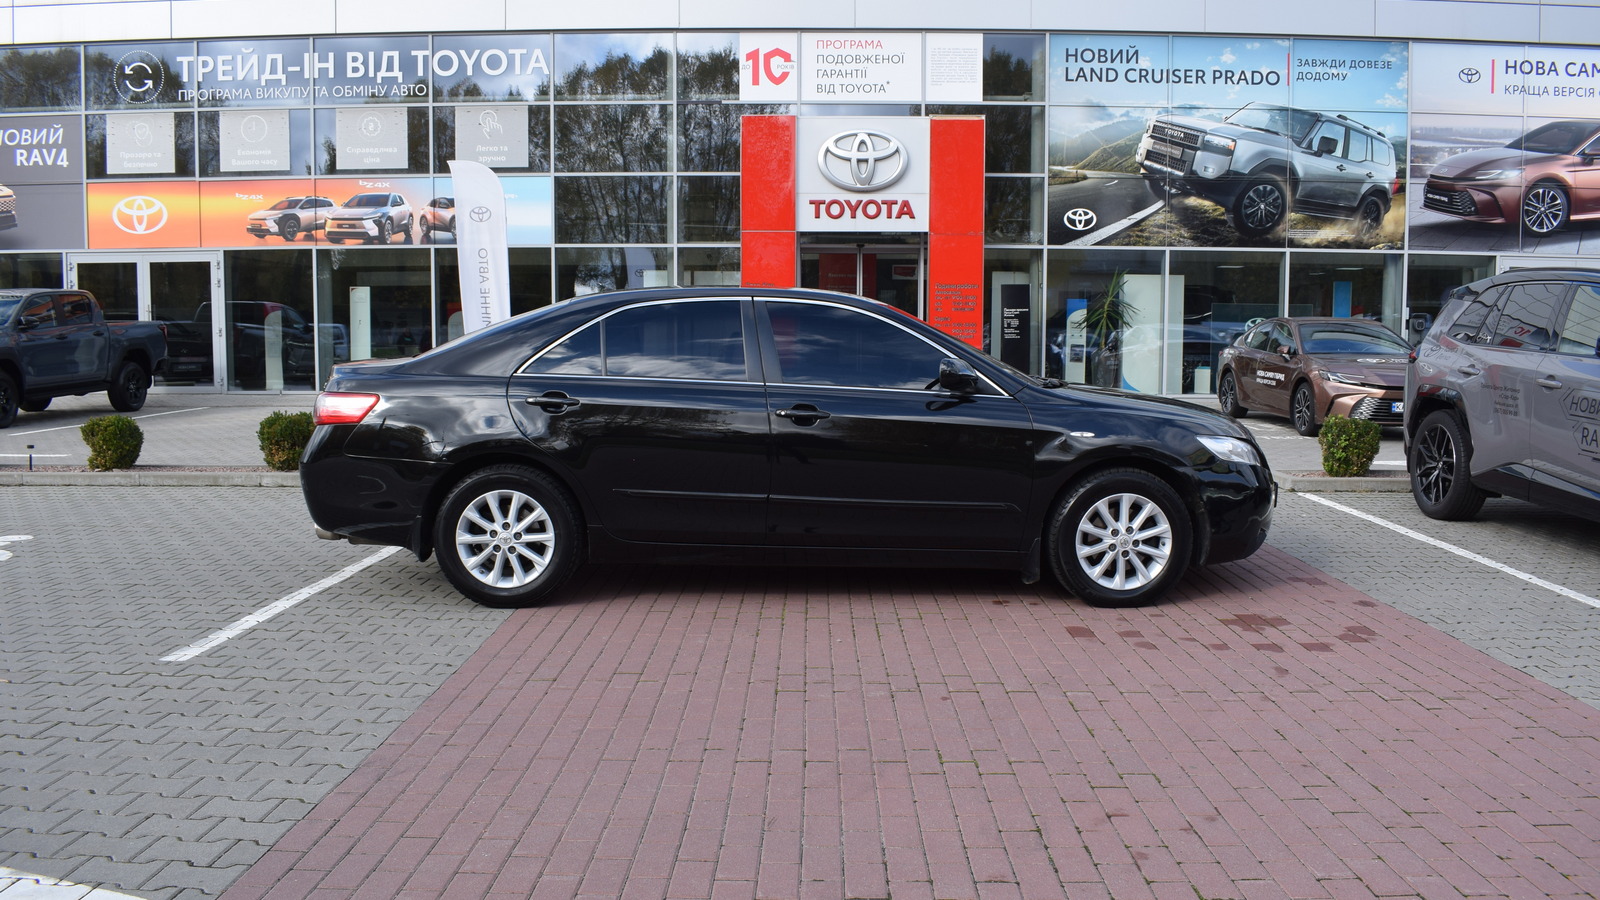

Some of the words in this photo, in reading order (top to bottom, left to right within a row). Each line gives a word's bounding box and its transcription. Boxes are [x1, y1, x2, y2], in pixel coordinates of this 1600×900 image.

[816, 39, 884, 50] ПРОГРАМА
[816, 52, 906, 66] ПОДОВЖЕНОЇ
[1064, 45, 1140, 64] НОВИЙ
[176, 47, 335, 86] ТРЕЙД-ІН
[346, 50, 403, 84] ВІД
[411, 48, 550, 77] TOYOTA
[1296, 58, 1347, 69] ЗАВЖДИ
[1348, 58, 1393, 71] ДОВЕЗЕ
[1505, 59, 1560, 77] НОВА
[816, 66, 868, 79] ГАРАНТІЇ
[1064, 66, 1119, 83] LAND
[1124, 67, 1207, 85] CRUISER
[1212, 69, 1281, 87] PRADO
[1296, 71, 1348, 83] ДОДОМУ
[178, 88, 253, 101] ПРОГРАМА
[256, 87, 310, 99] ВИКУПУ
[315, 86, 330, 98] ТА
[332, 84, 388, 98] ОБМІНУ
[390, 83, 428, 97] АВТО
[816, 83, 837, 95] ВІД
[1504, 84, 1550, 98] КРАЩА
[1553, 86, 1595, 98] ВЕРСІЯ
[476, 144, 499, 152] Легко
[15, 148, 69, 168] RAV4
[261, 158, 278, 167] часу
[363, 156, 381, 164] ціна
[477, 154, 507, 163] зручно
[808, 198, 916, 220] TOYOTA
